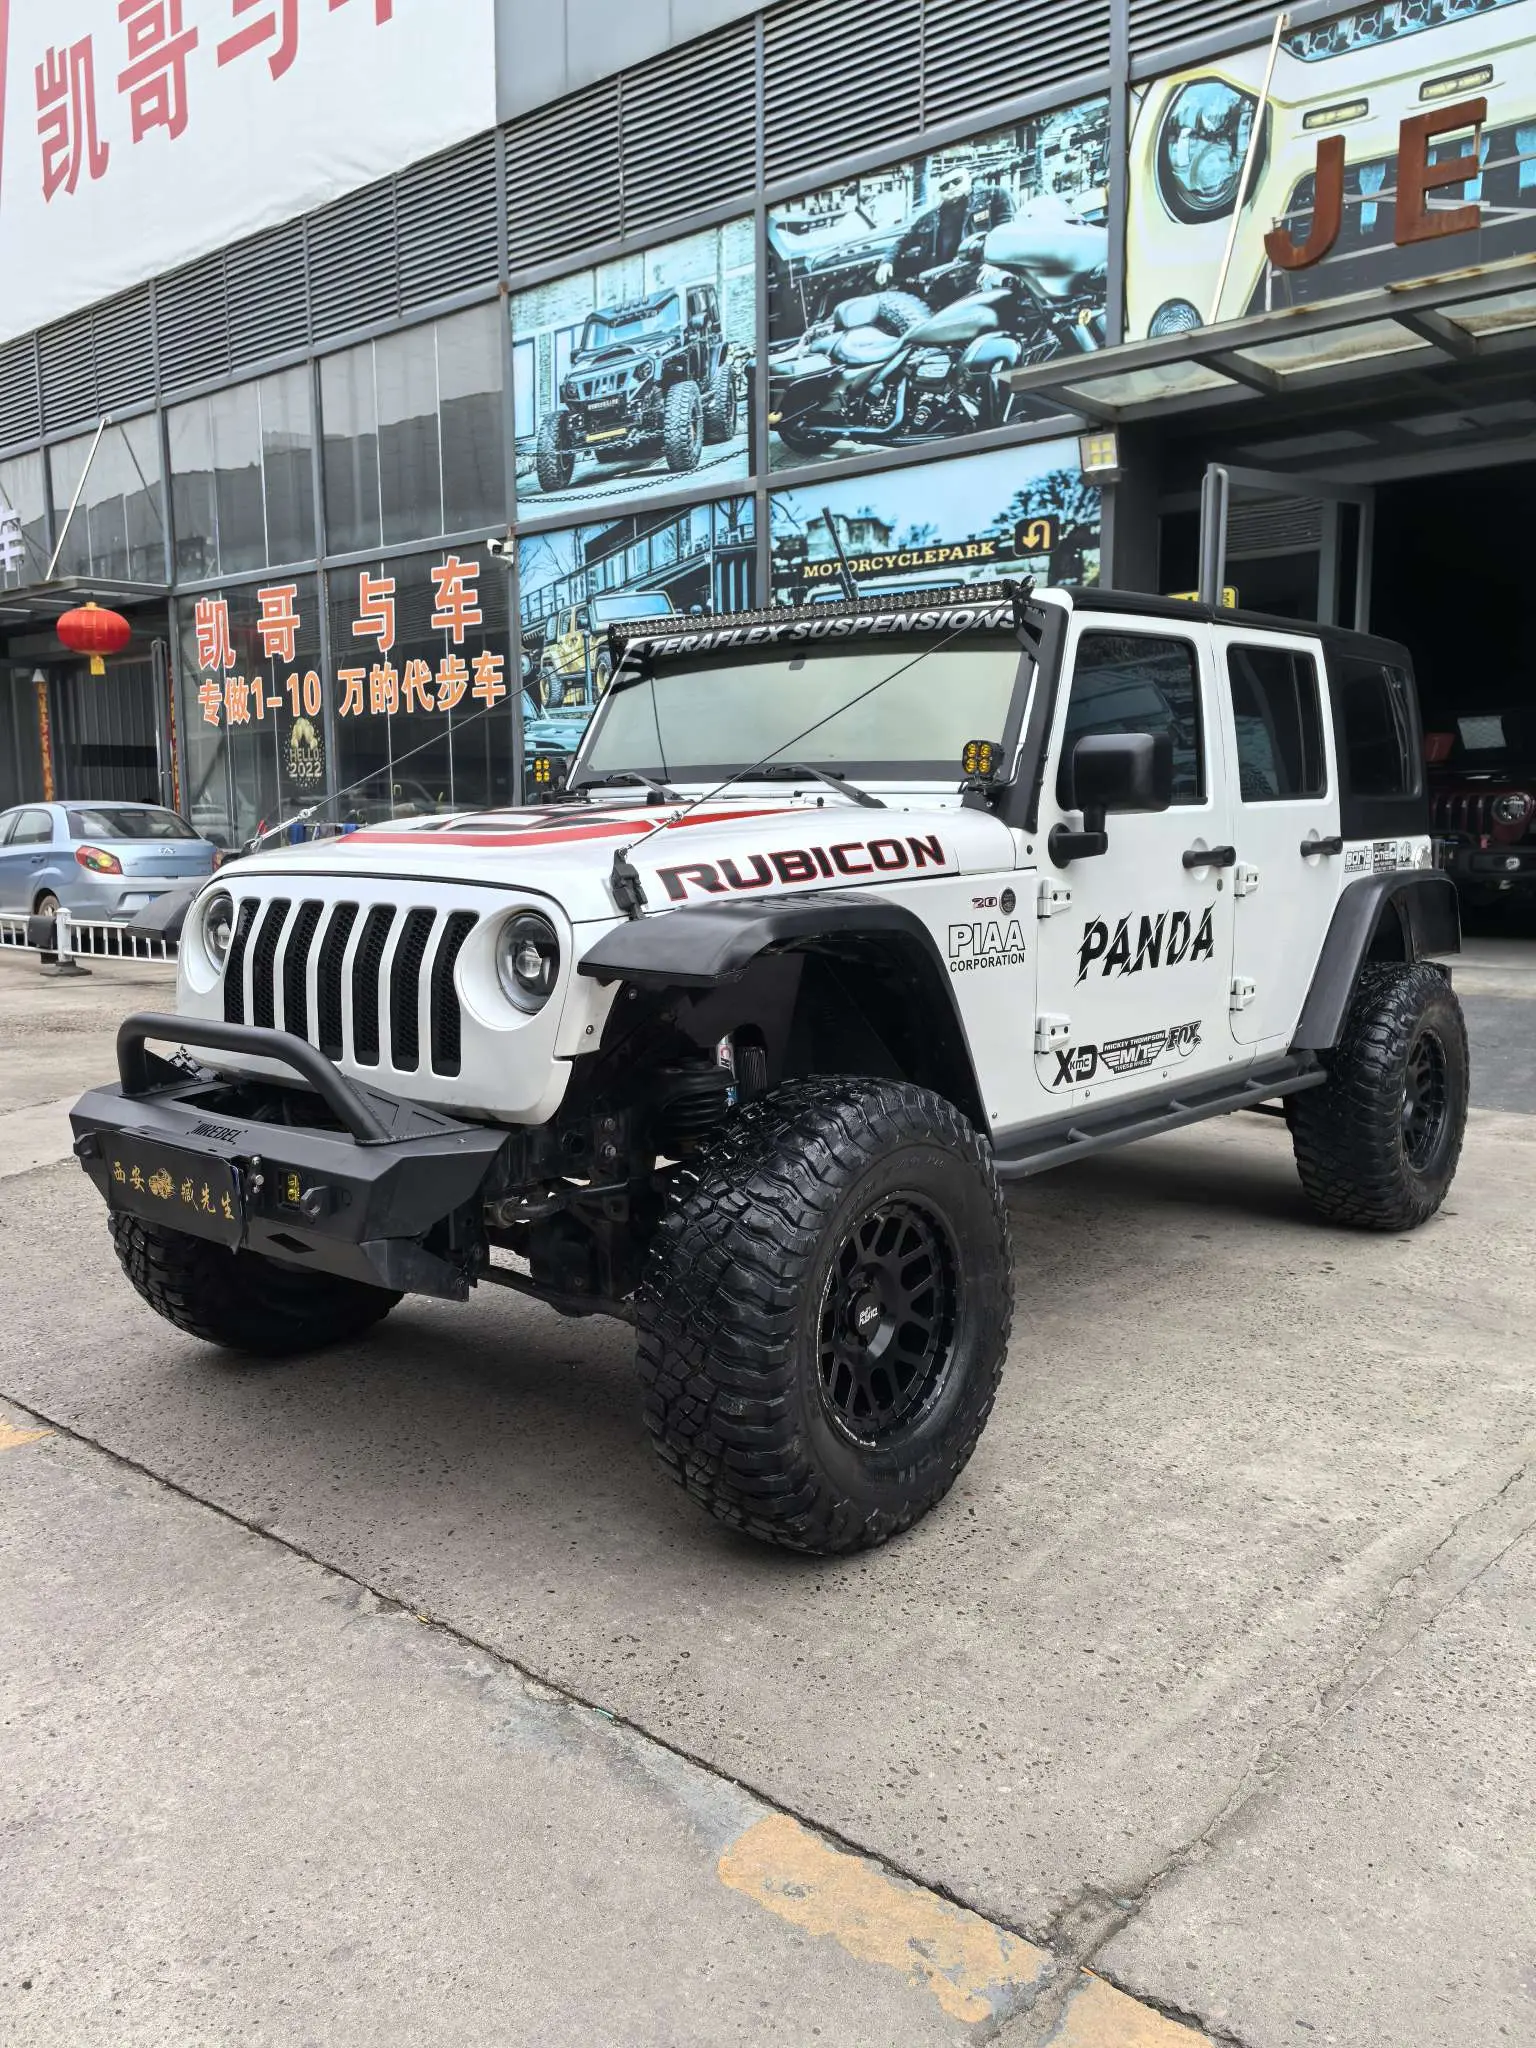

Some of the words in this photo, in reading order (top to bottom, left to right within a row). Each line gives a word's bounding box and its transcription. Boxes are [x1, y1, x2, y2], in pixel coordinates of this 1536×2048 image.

[194, 555, 483, 671] 凯哥与车
[650, 624, 790, 658] TERAFLEX
[789, 607, 1016, 641] SUSPENSIONS
[288, 761, 322, 778] 2022
[289, 747, 320, 763] HELLO
[655, 834, 946, 901] RUBICON
[948, 919, 1026, 959] PIAA
[1073, 900, 1217, 988] PANDA
[949, 952, 1026, 973] CORPORATION
[1103, 1040, 1129, 1052] MICKEY
[1130, 1032, 1166, 1046] THOMPSON
[1165, 1020, 1202, 1051] FOX
[1052, 1044, 1099, 1087] XD
[1119, 1044, 1152, 1064] M/T
